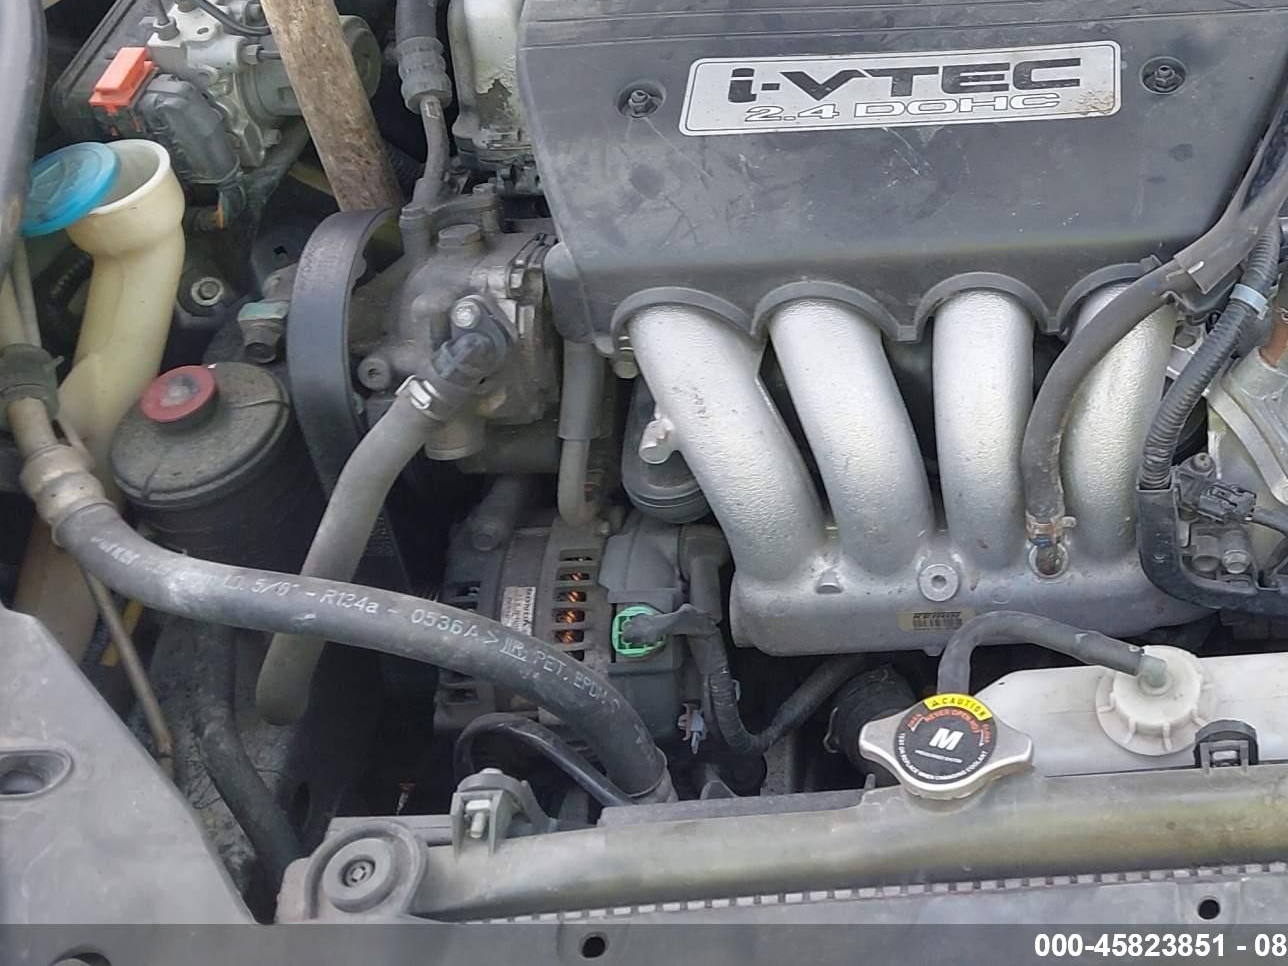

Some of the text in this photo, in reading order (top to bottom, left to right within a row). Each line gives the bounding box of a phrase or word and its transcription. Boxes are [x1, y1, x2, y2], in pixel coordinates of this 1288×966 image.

[728, 58, 1081, 104] i-VTEC
[744, 92, 1061, 123] 2.4 DOHC
[320, 592, 379, 617] R134a
[942, 697, 986, 716] CAUTION
[929, 728, 964, 750] M
